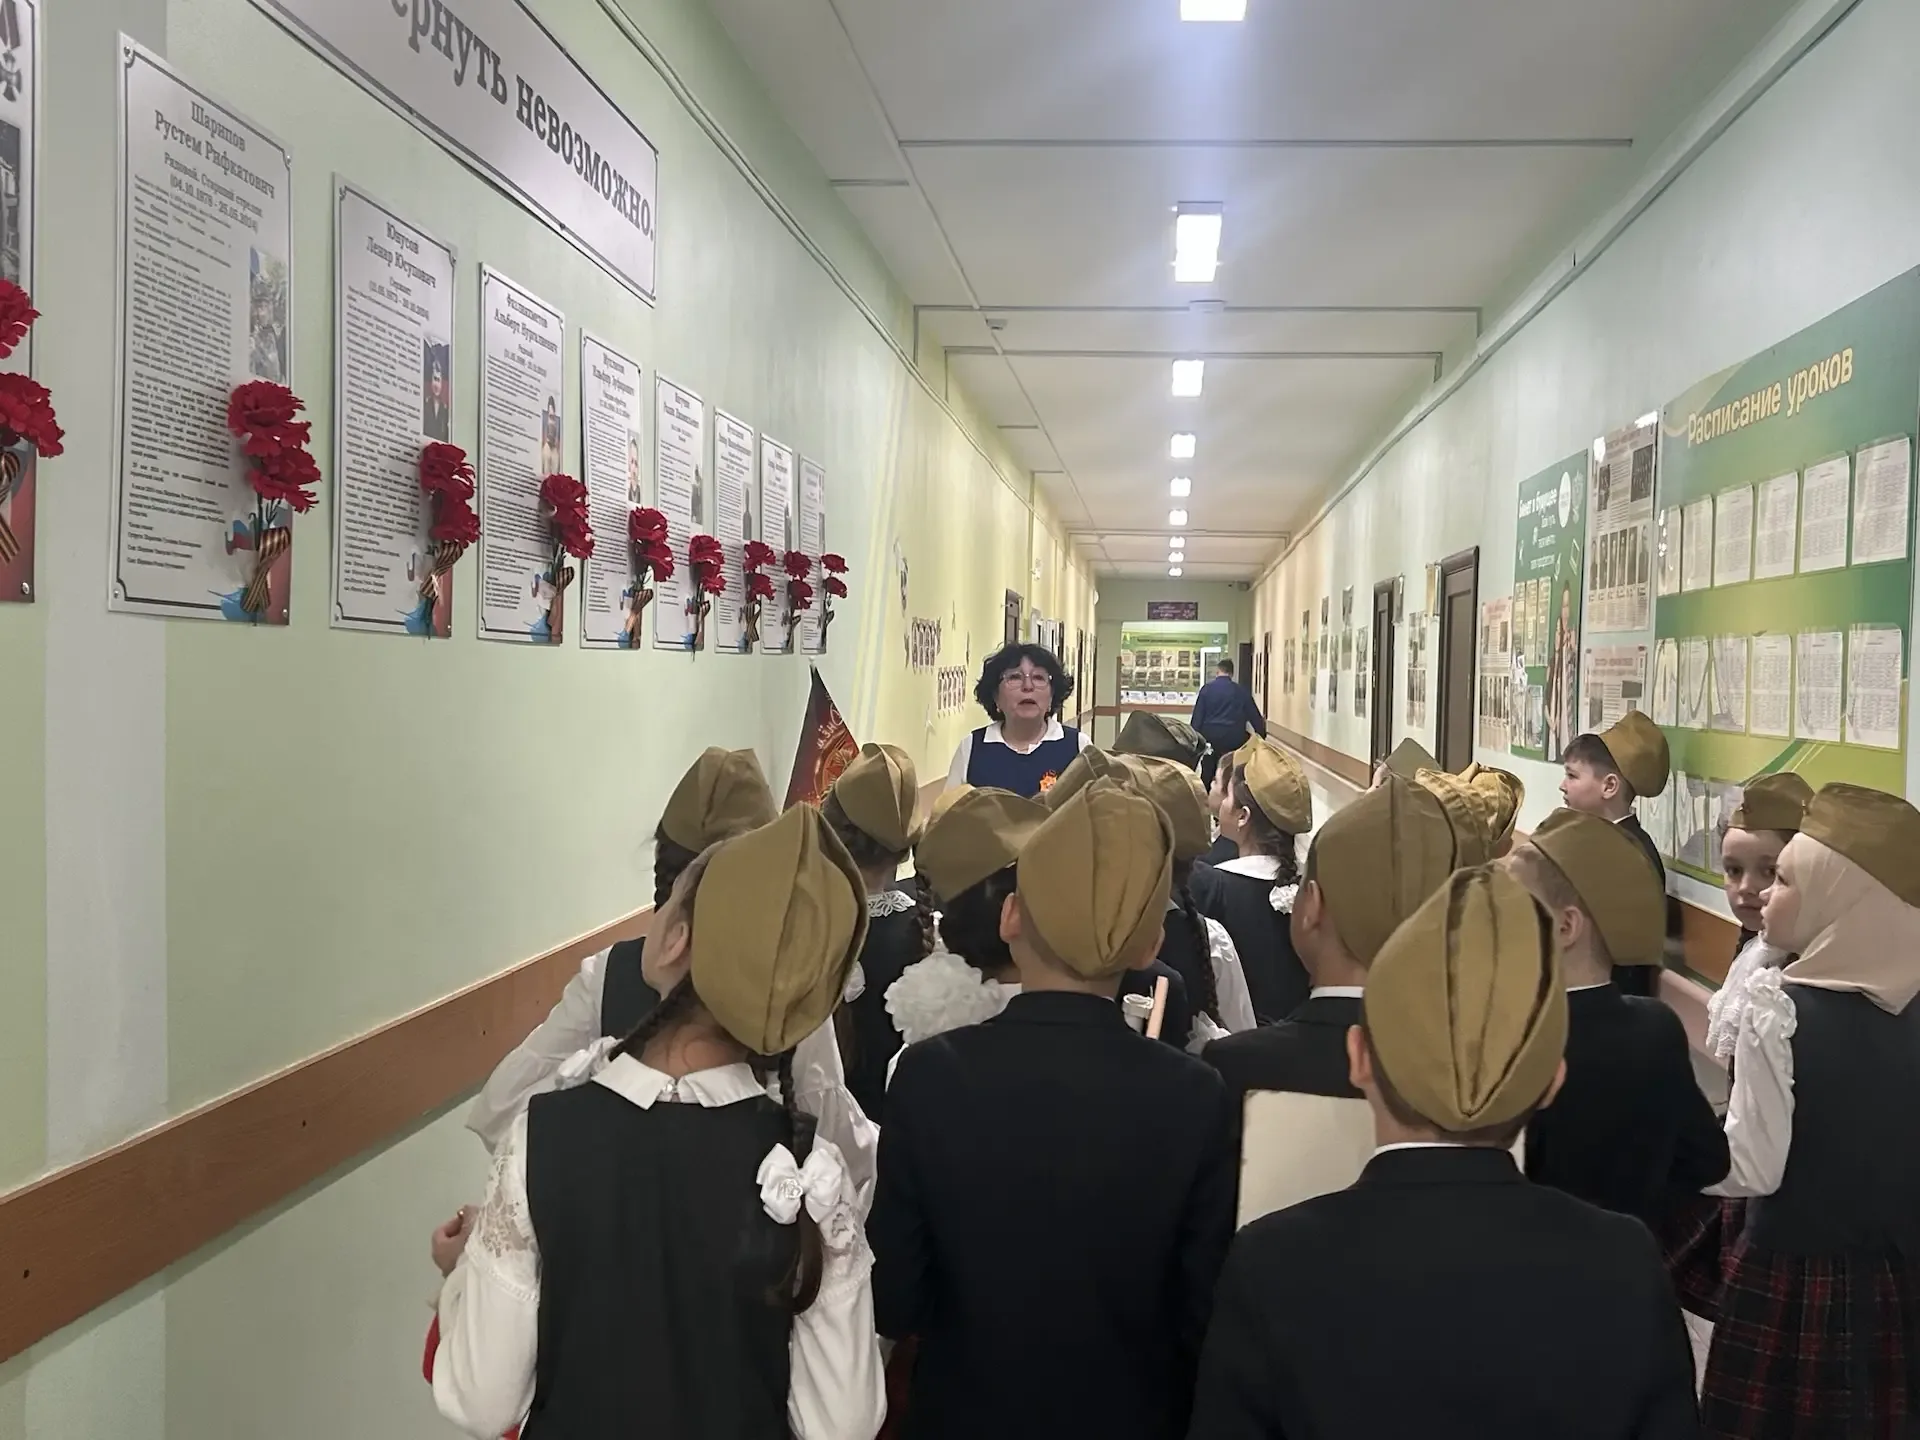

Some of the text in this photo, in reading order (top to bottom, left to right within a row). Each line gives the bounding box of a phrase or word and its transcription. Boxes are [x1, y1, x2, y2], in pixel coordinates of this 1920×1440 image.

[154, 109, 275, 199] Рустем Рифкатович
[191, 101, 246, 152] Шарипов
[516, 74, 654, 242] невозможно.
[366, 236, 436, 288] Ленар Юсупович
[386, 221, 419, 255] Юнусов
[1687, 347, 1853, 448] Расписание уроков
